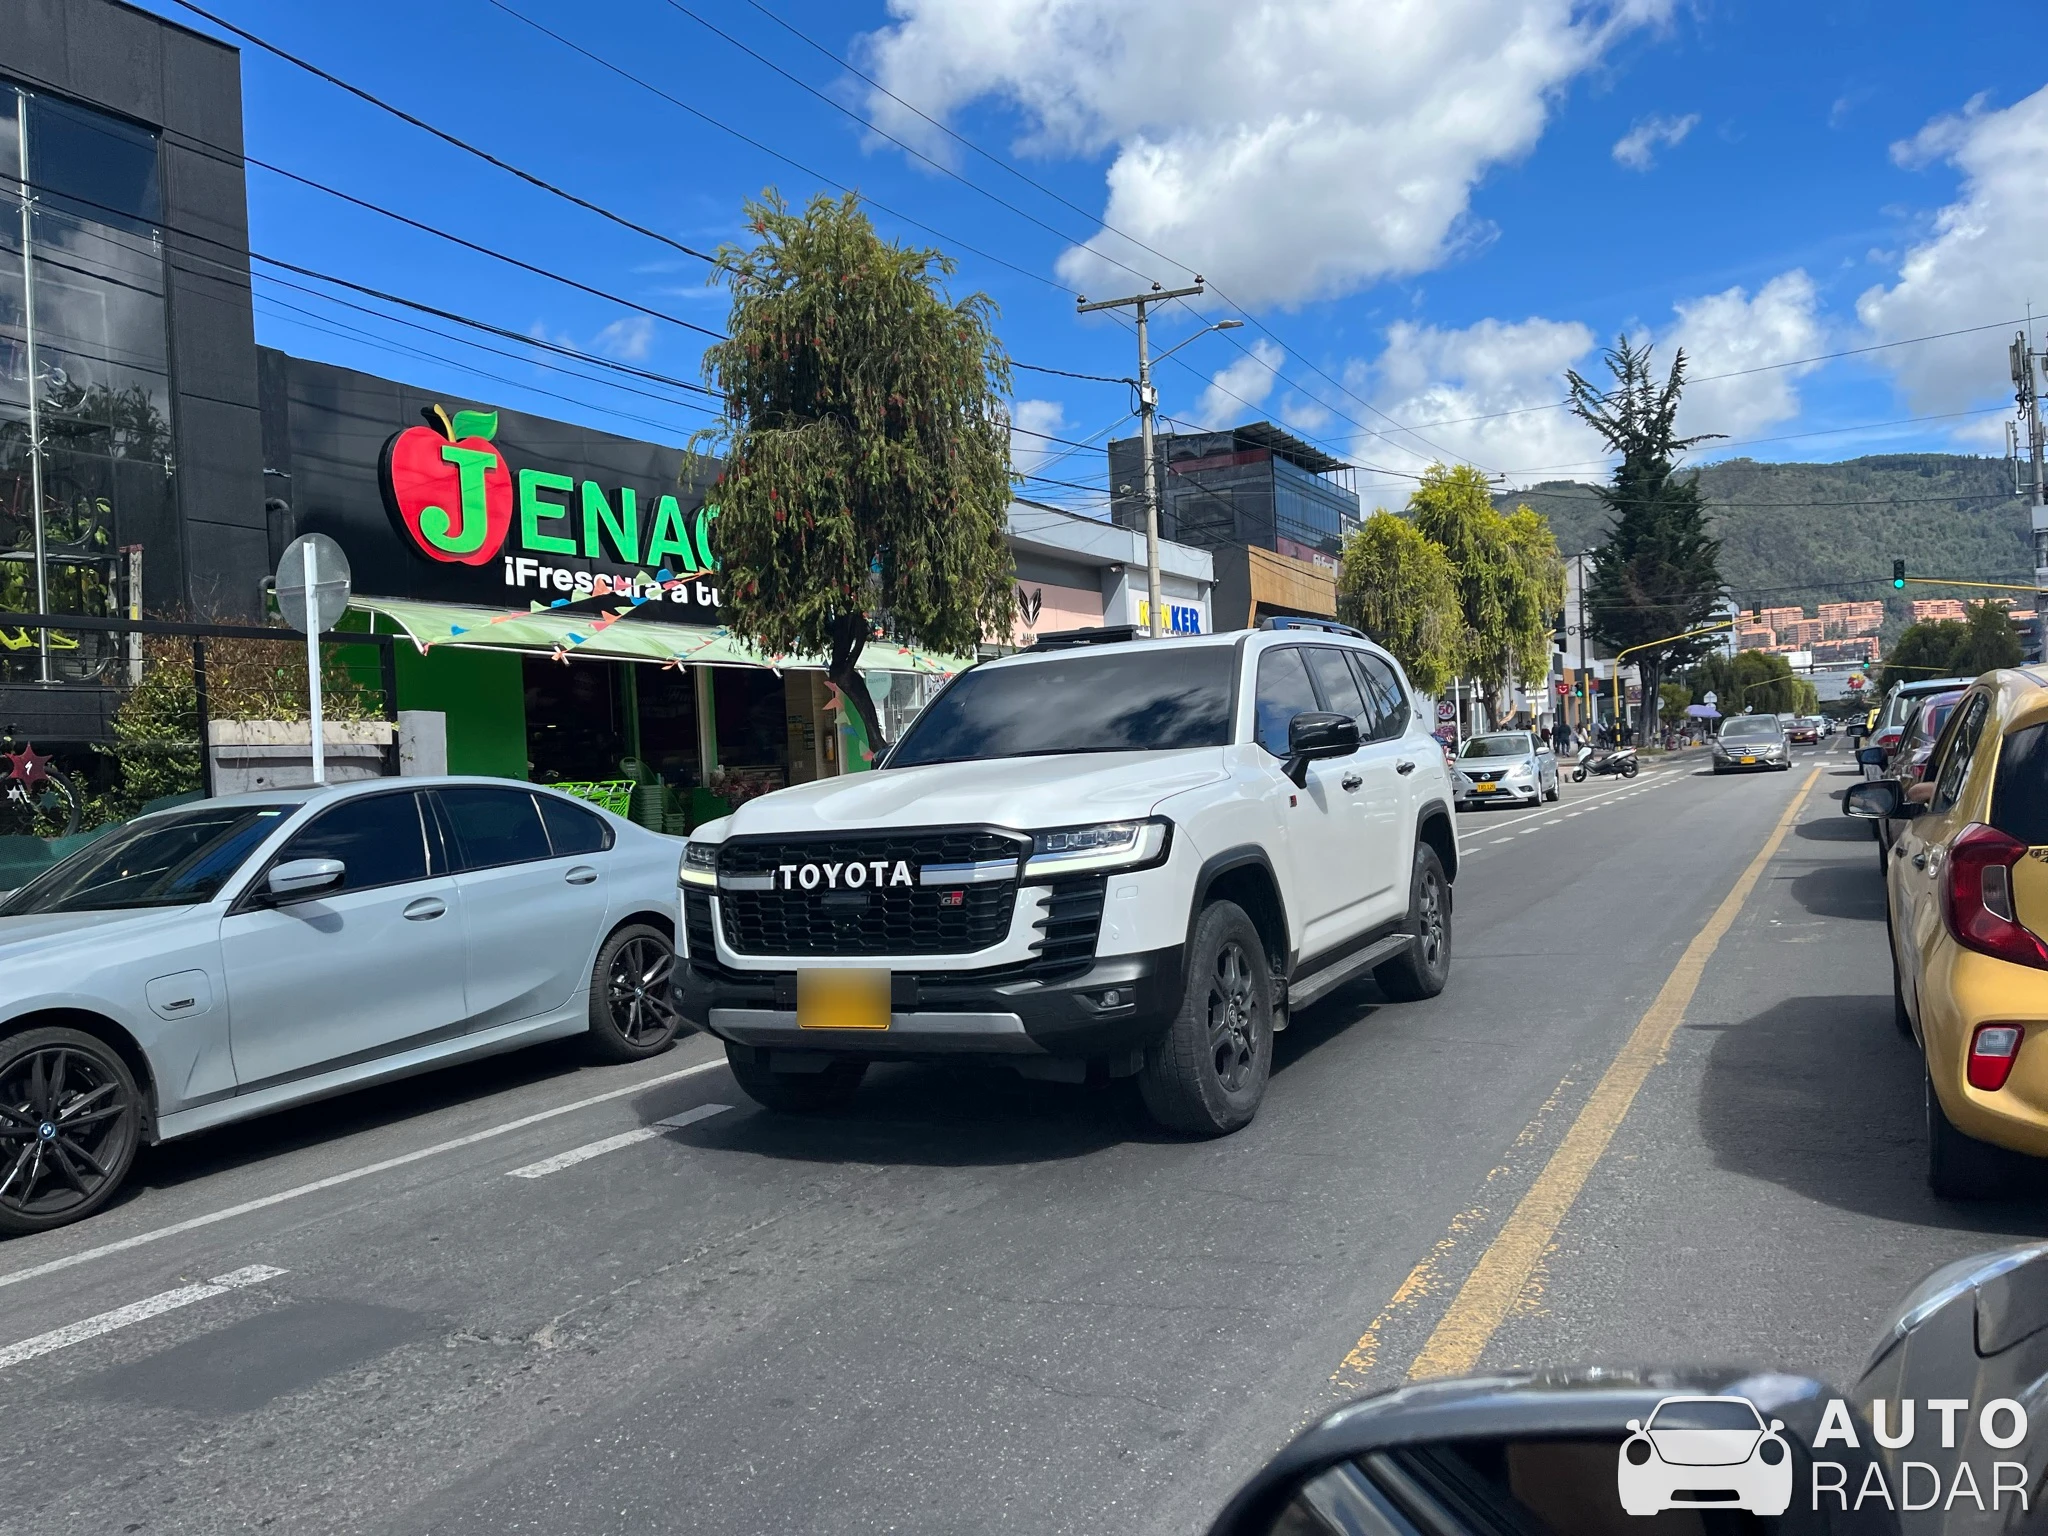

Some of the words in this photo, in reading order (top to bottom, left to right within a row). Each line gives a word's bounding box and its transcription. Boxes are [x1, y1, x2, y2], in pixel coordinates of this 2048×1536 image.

[670, 583, 689, 604] a
[1139, 599, 1201, 635] KNKER
[1438, 704, 1453, 715] 50
[778, 860, 913, 890] TOYOTA
